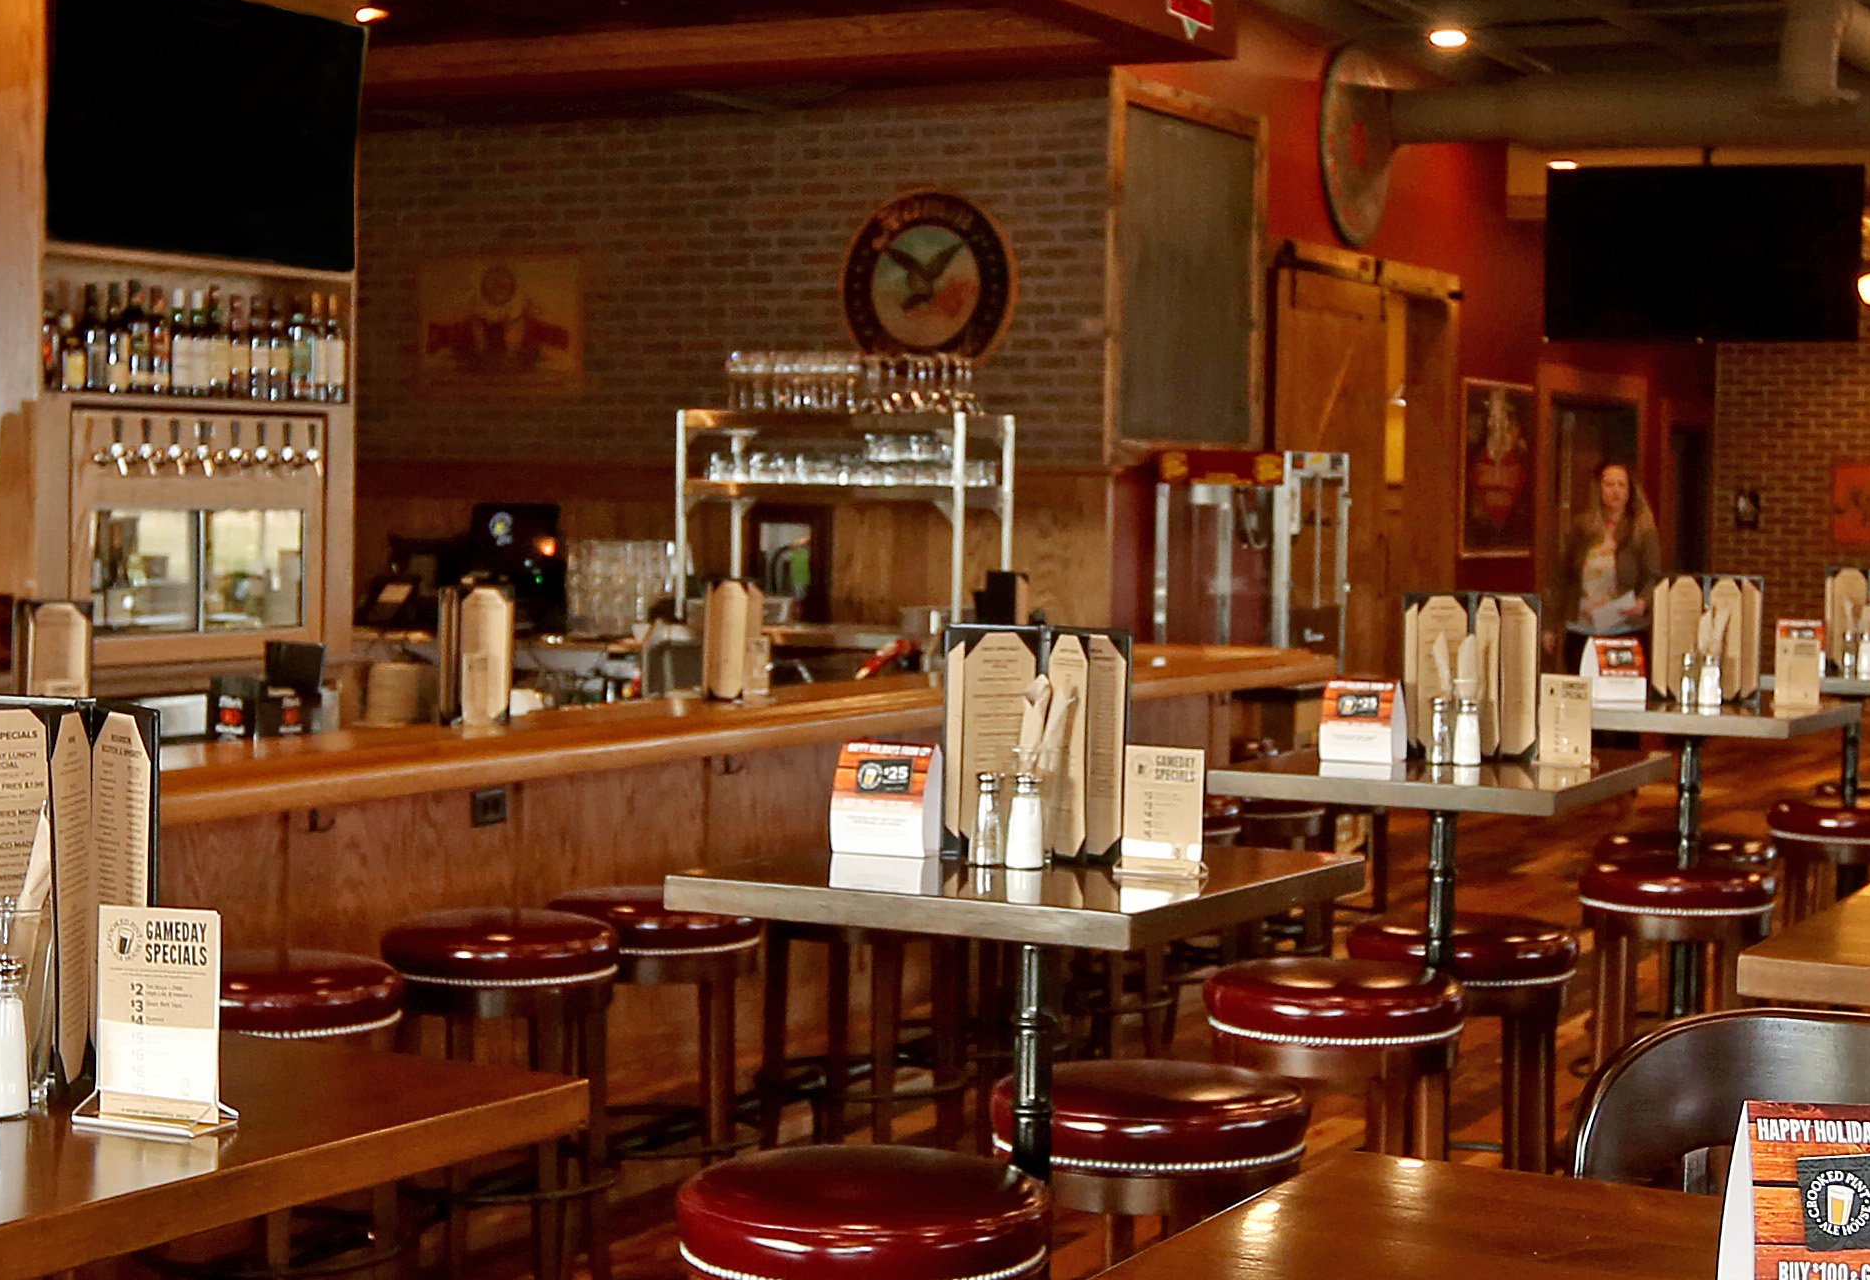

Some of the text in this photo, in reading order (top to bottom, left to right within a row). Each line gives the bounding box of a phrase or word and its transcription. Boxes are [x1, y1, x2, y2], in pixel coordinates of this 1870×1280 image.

[8, 750, 37, 760] LUNCH
[145, 920, 208, 943] GAMEDAY
[145, 943, 208, 967] SPECIALS
[130, 982, 144, 997] $2
[130, 999, 144, 1013] $3
[1756, 1118, 1812, 1142] HAPPY
[1805, 1170, 1845, 1219] CROOKED
[1819, 1219, 1841, 1236] ALE
